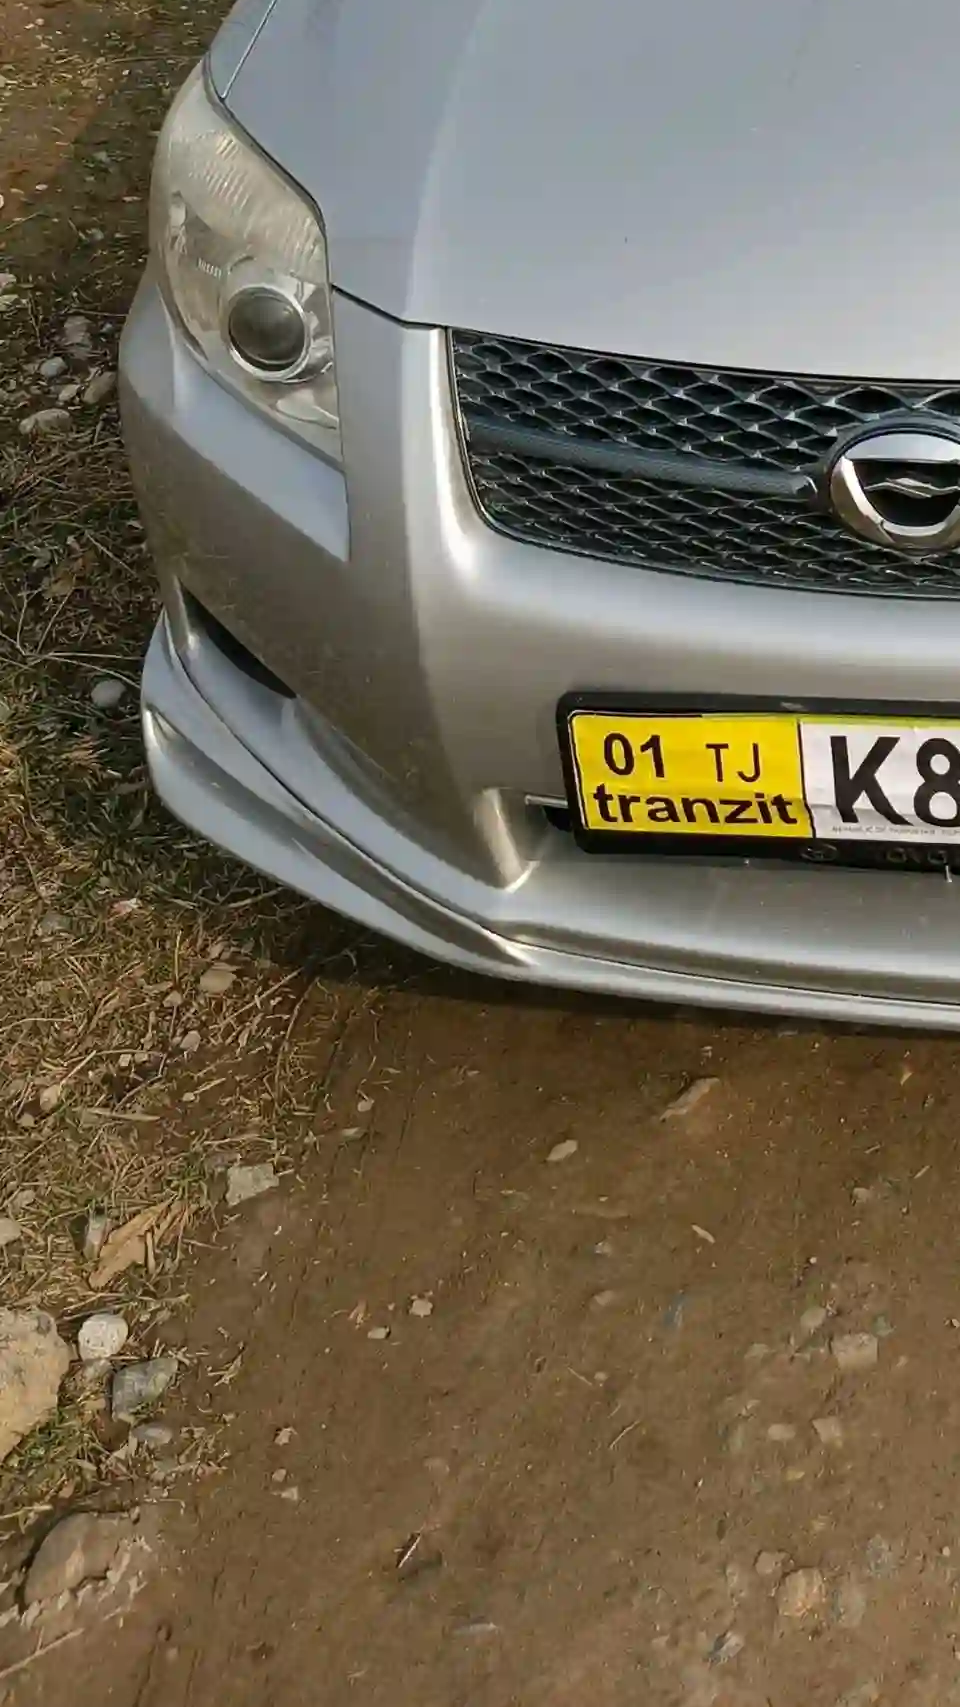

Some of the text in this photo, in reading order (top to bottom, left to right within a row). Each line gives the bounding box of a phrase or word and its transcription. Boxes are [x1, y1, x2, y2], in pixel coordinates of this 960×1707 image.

[603, 732, 762, 783] 01 TJ
[592, 782, 799, 825] tranzit
